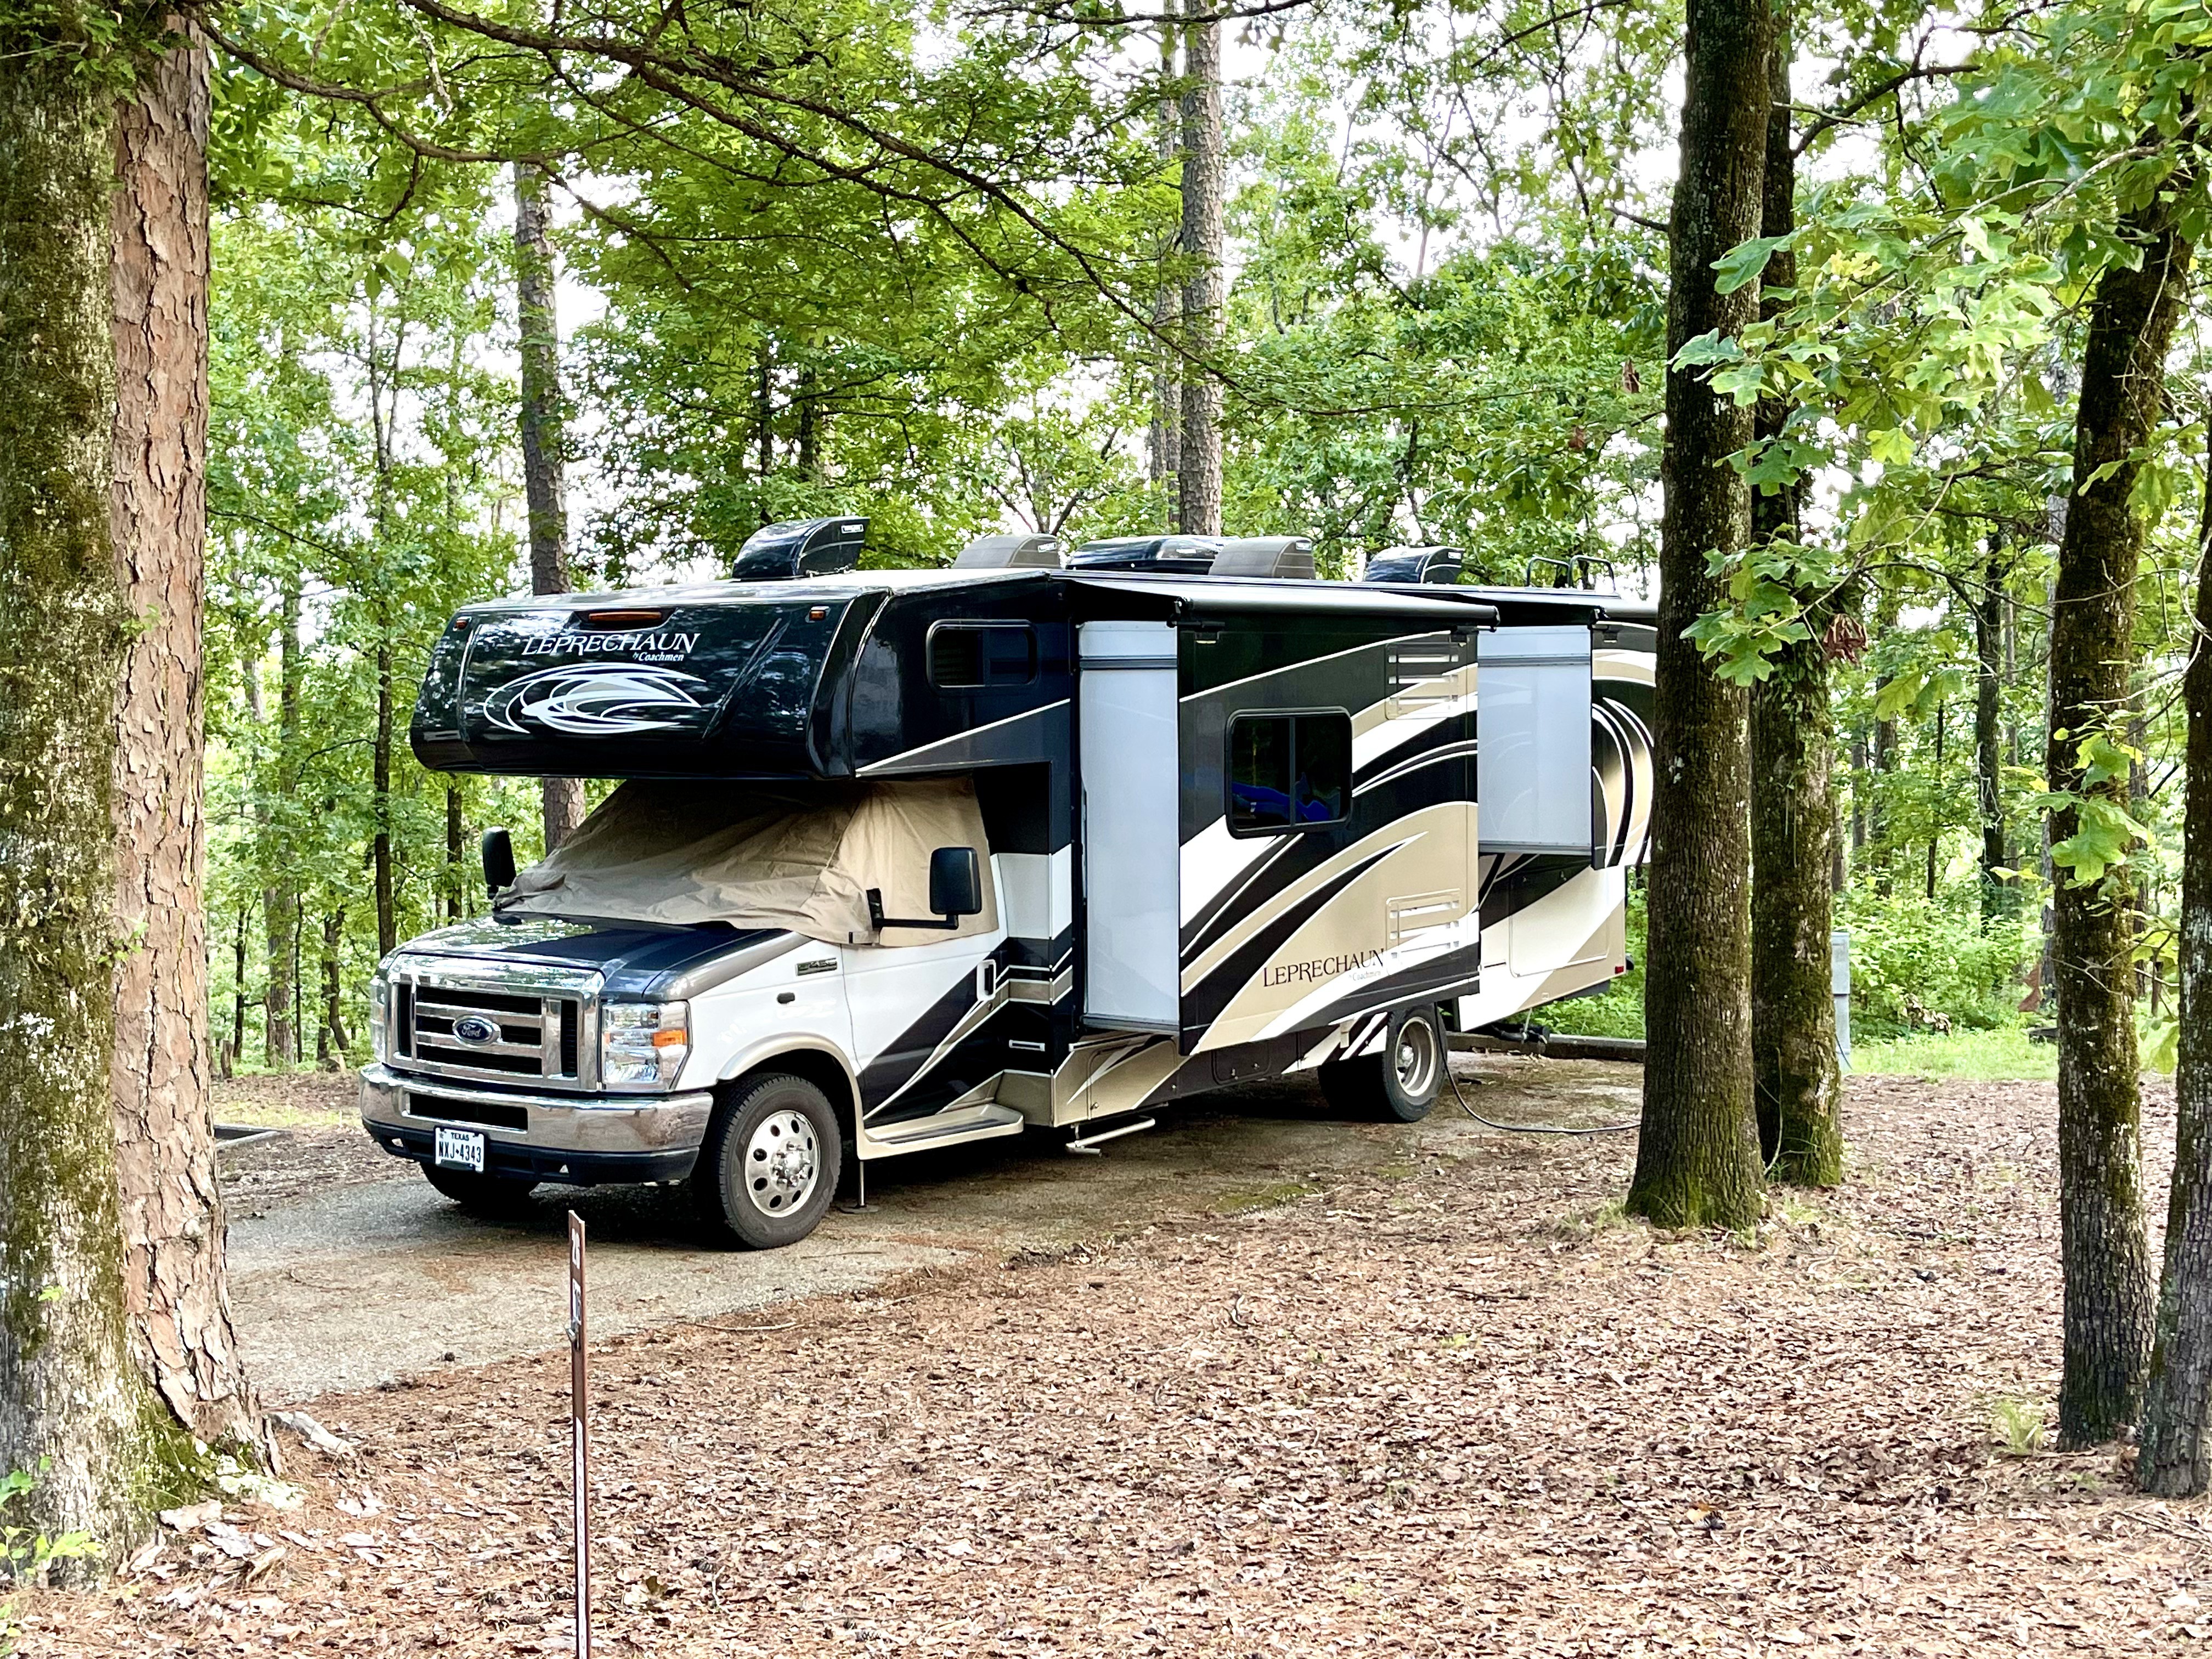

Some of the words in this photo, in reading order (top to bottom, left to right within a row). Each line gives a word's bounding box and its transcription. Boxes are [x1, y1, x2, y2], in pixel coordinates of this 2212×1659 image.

[522, 633, 700, 656] LEPRECHAUN
[639, 652, 684, 661] Coachmen
[1263, 949, 1384, 987] LEPRECHAUN
[461, 1023, 481, 1037] Ford
[451, 1132, 469, 1141] TEXAS
